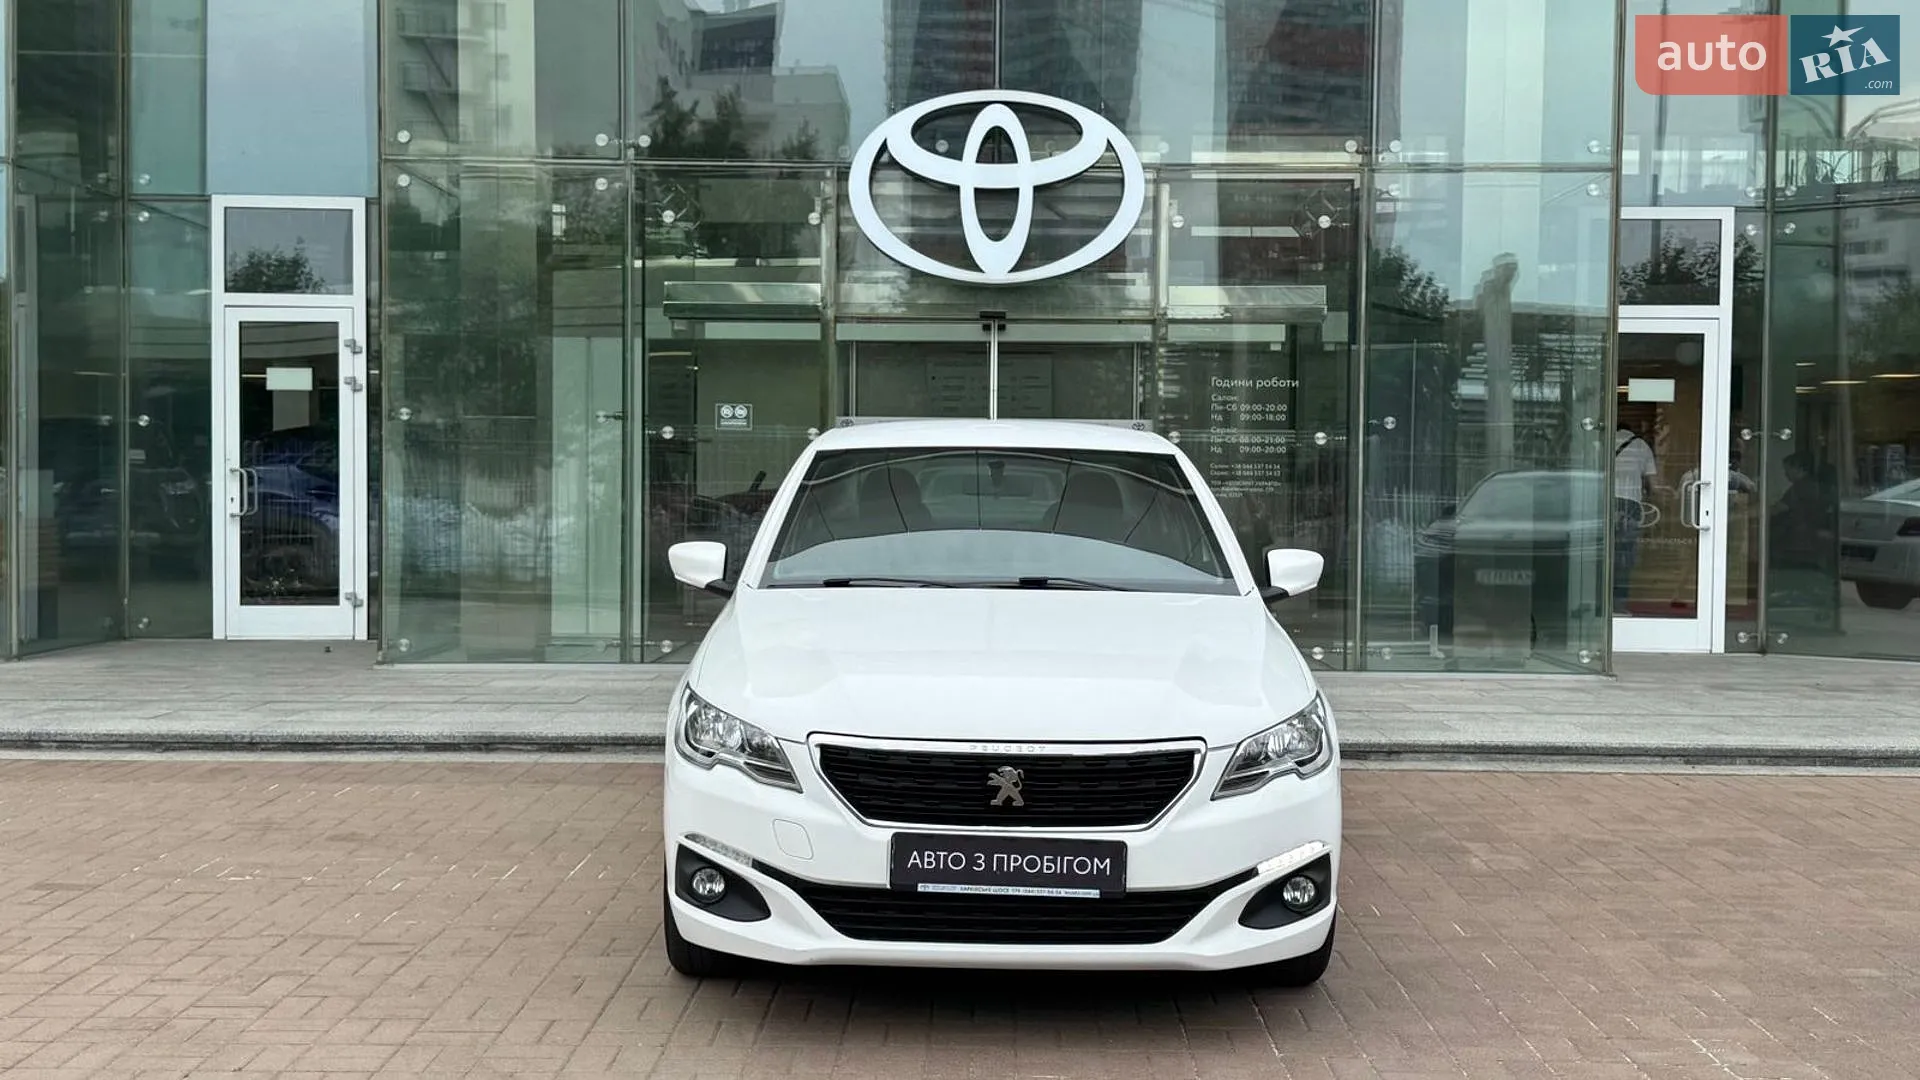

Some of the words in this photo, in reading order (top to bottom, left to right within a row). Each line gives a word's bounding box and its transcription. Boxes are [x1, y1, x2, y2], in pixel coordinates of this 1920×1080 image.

[1211, 376, 1253, 388] Години
[1256, 377, 1300, 389] роботи
[969, 744, 1046, 752] PEUGEOT
[907, 849, 966, 870] АВТО
[993, 854, 1111, 876] ПРОБІГОМ
